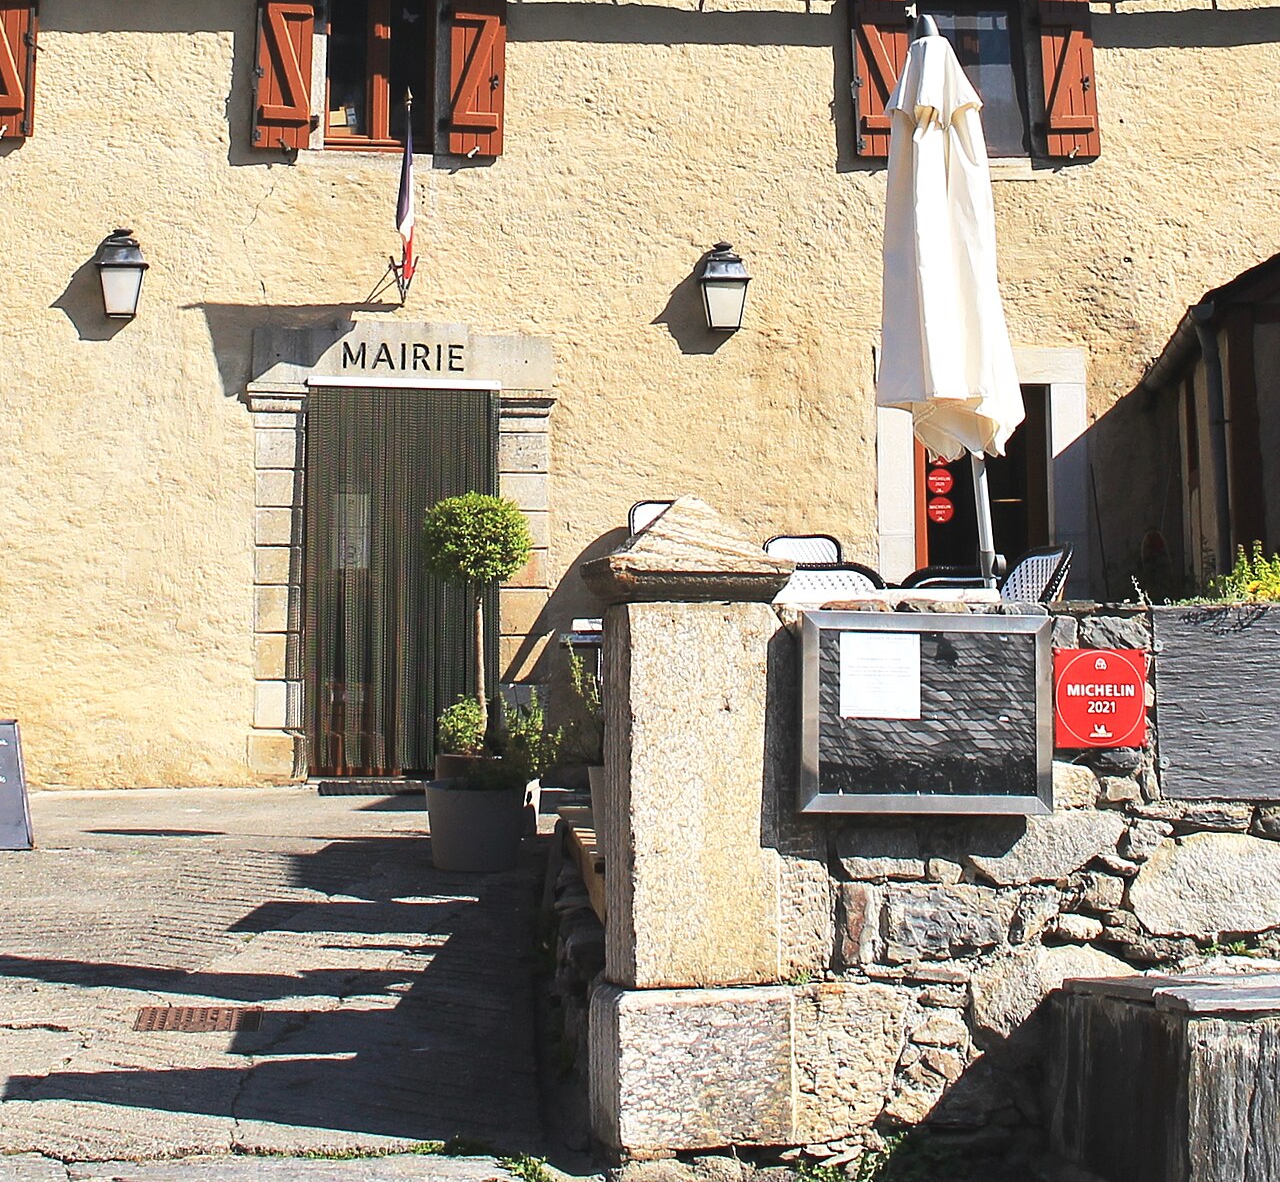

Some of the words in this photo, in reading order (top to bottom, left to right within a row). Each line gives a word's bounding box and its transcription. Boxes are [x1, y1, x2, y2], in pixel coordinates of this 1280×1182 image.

[342, 341, 465, 372] MAIRIE
[1066, 683, 1136, 697] MICHELIN
[1087, 700, 1117, 714] 2021
